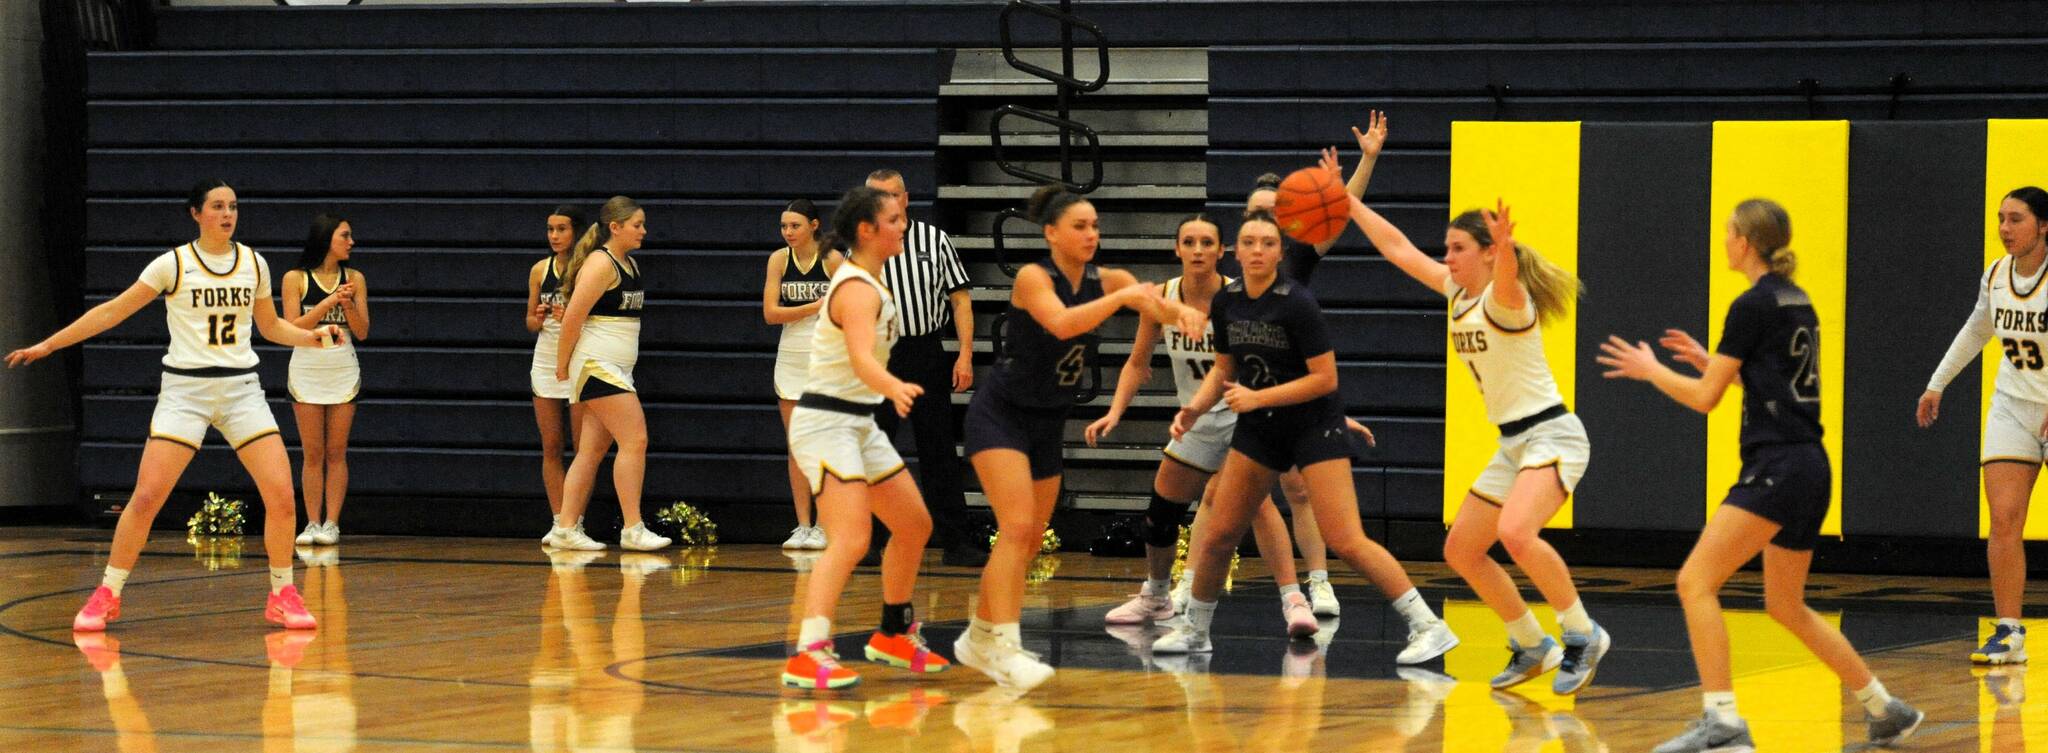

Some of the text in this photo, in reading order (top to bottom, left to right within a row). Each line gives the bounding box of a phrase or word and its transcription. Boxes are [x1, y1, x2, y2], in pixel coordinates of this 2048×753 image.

[191, 287, 252, 308] FORKS
[207, 313, 237, 346] 12
[1994, 307, 2048, 334] FORKS
[1056, 344, 1087, 386] 4
[2002, 337, 2045, 371] 23
